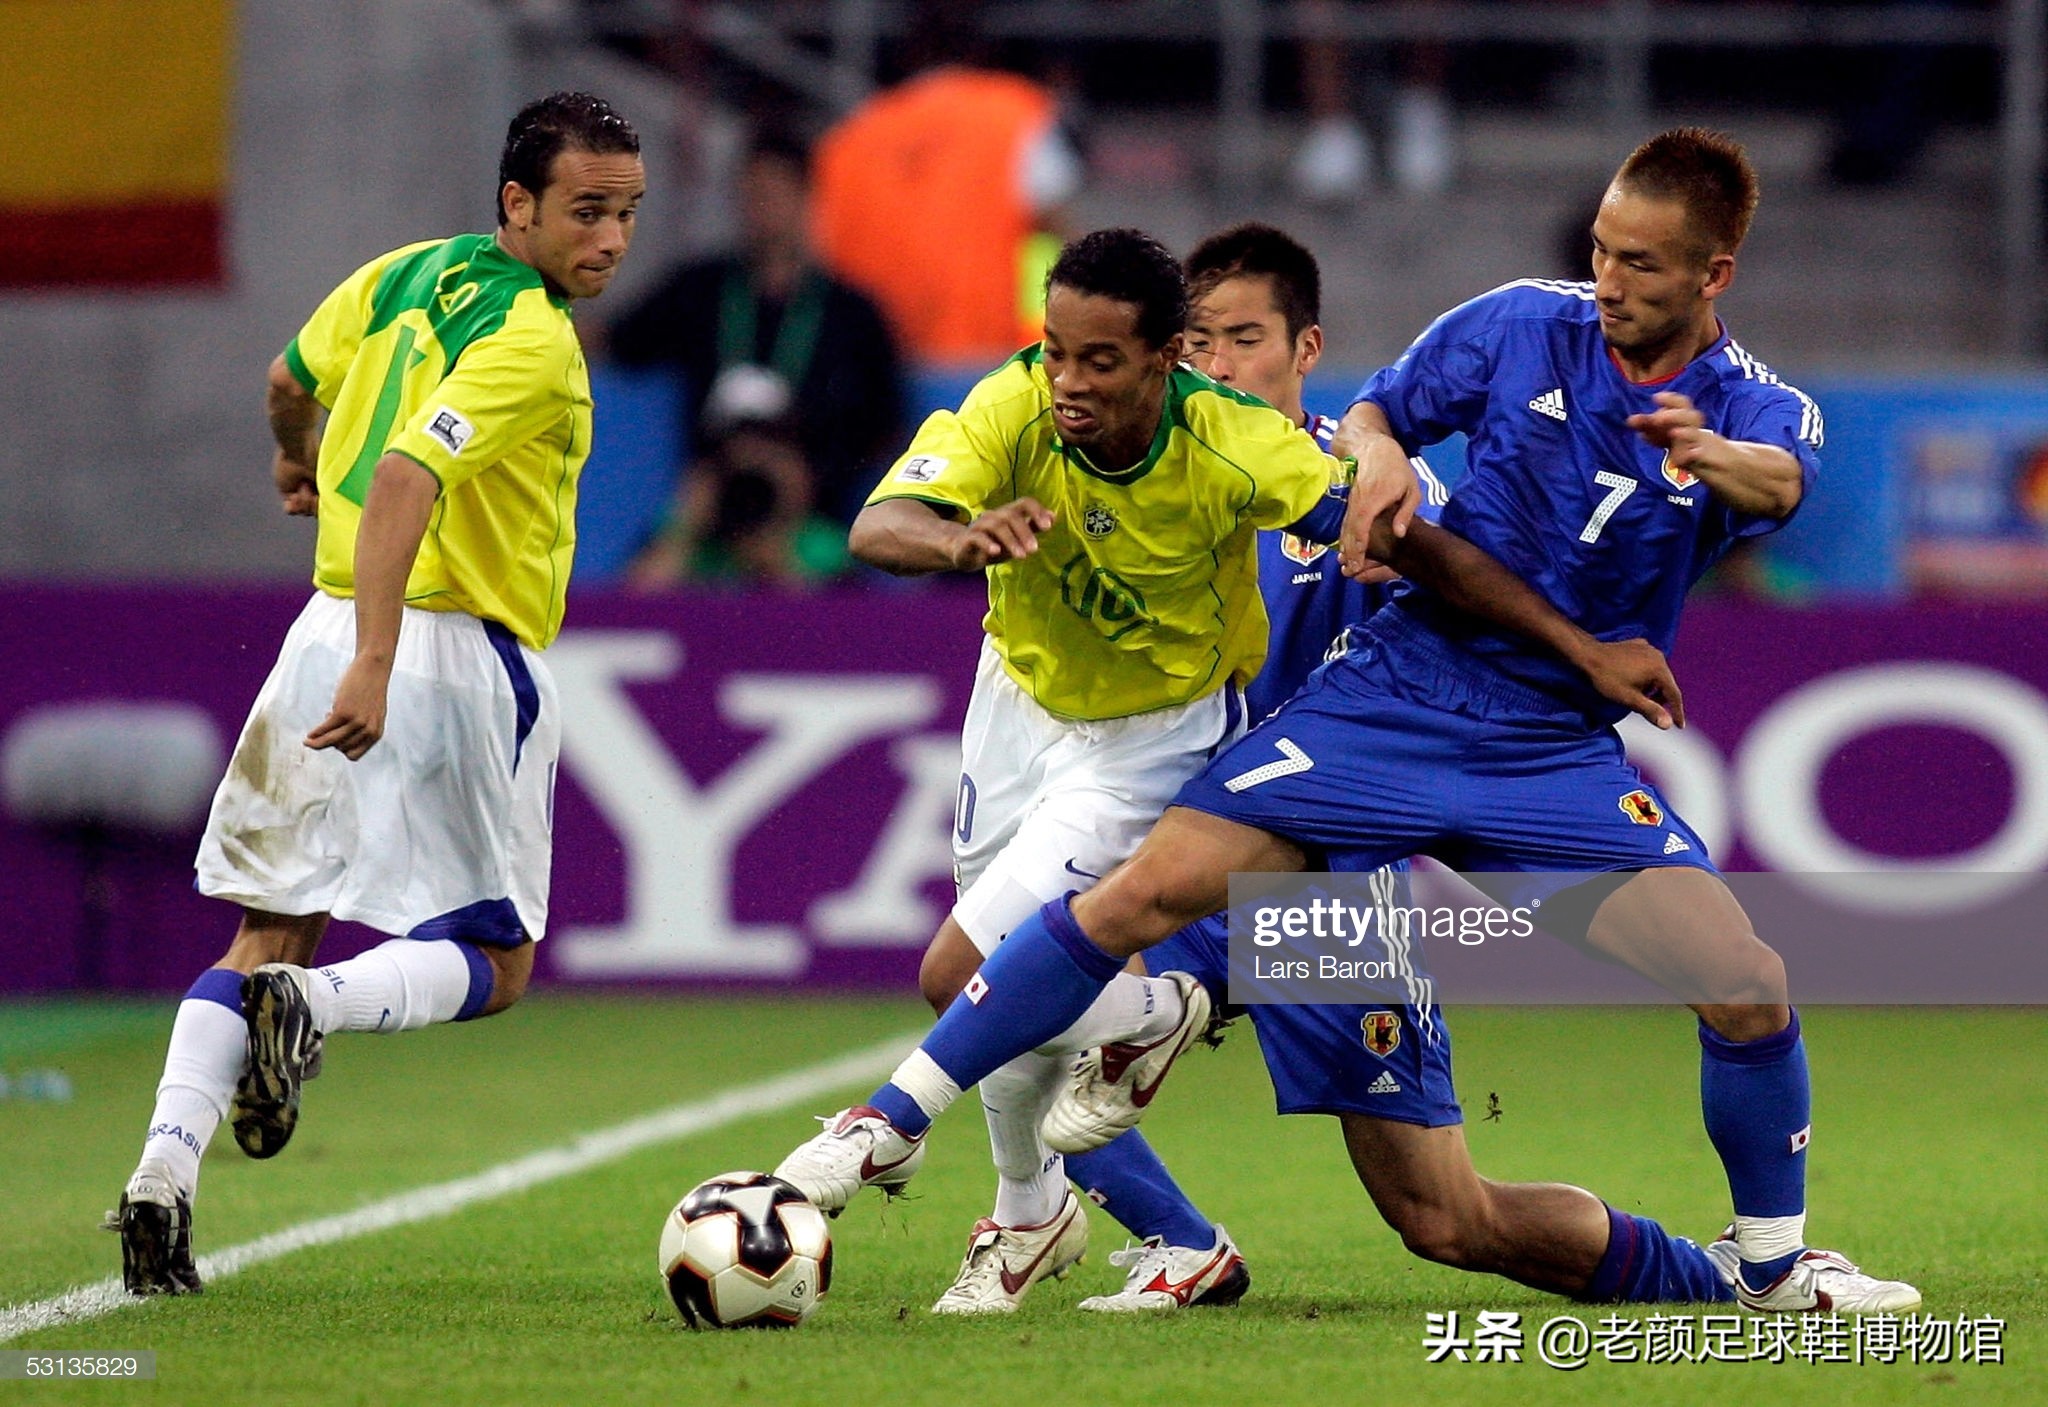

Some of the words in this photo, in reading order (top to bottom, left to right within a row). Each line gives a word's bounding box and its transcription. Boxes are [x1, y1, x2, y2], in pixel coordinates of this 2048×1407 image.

[1579, 470, 1638, 544] 7
[1061, 551, 1160, 641] 10
[1292, 571, 1322, 584] JAPAN
[1223, 737, 1315, 793] 7
[147, 1123, 201, 1158] BRASIL
